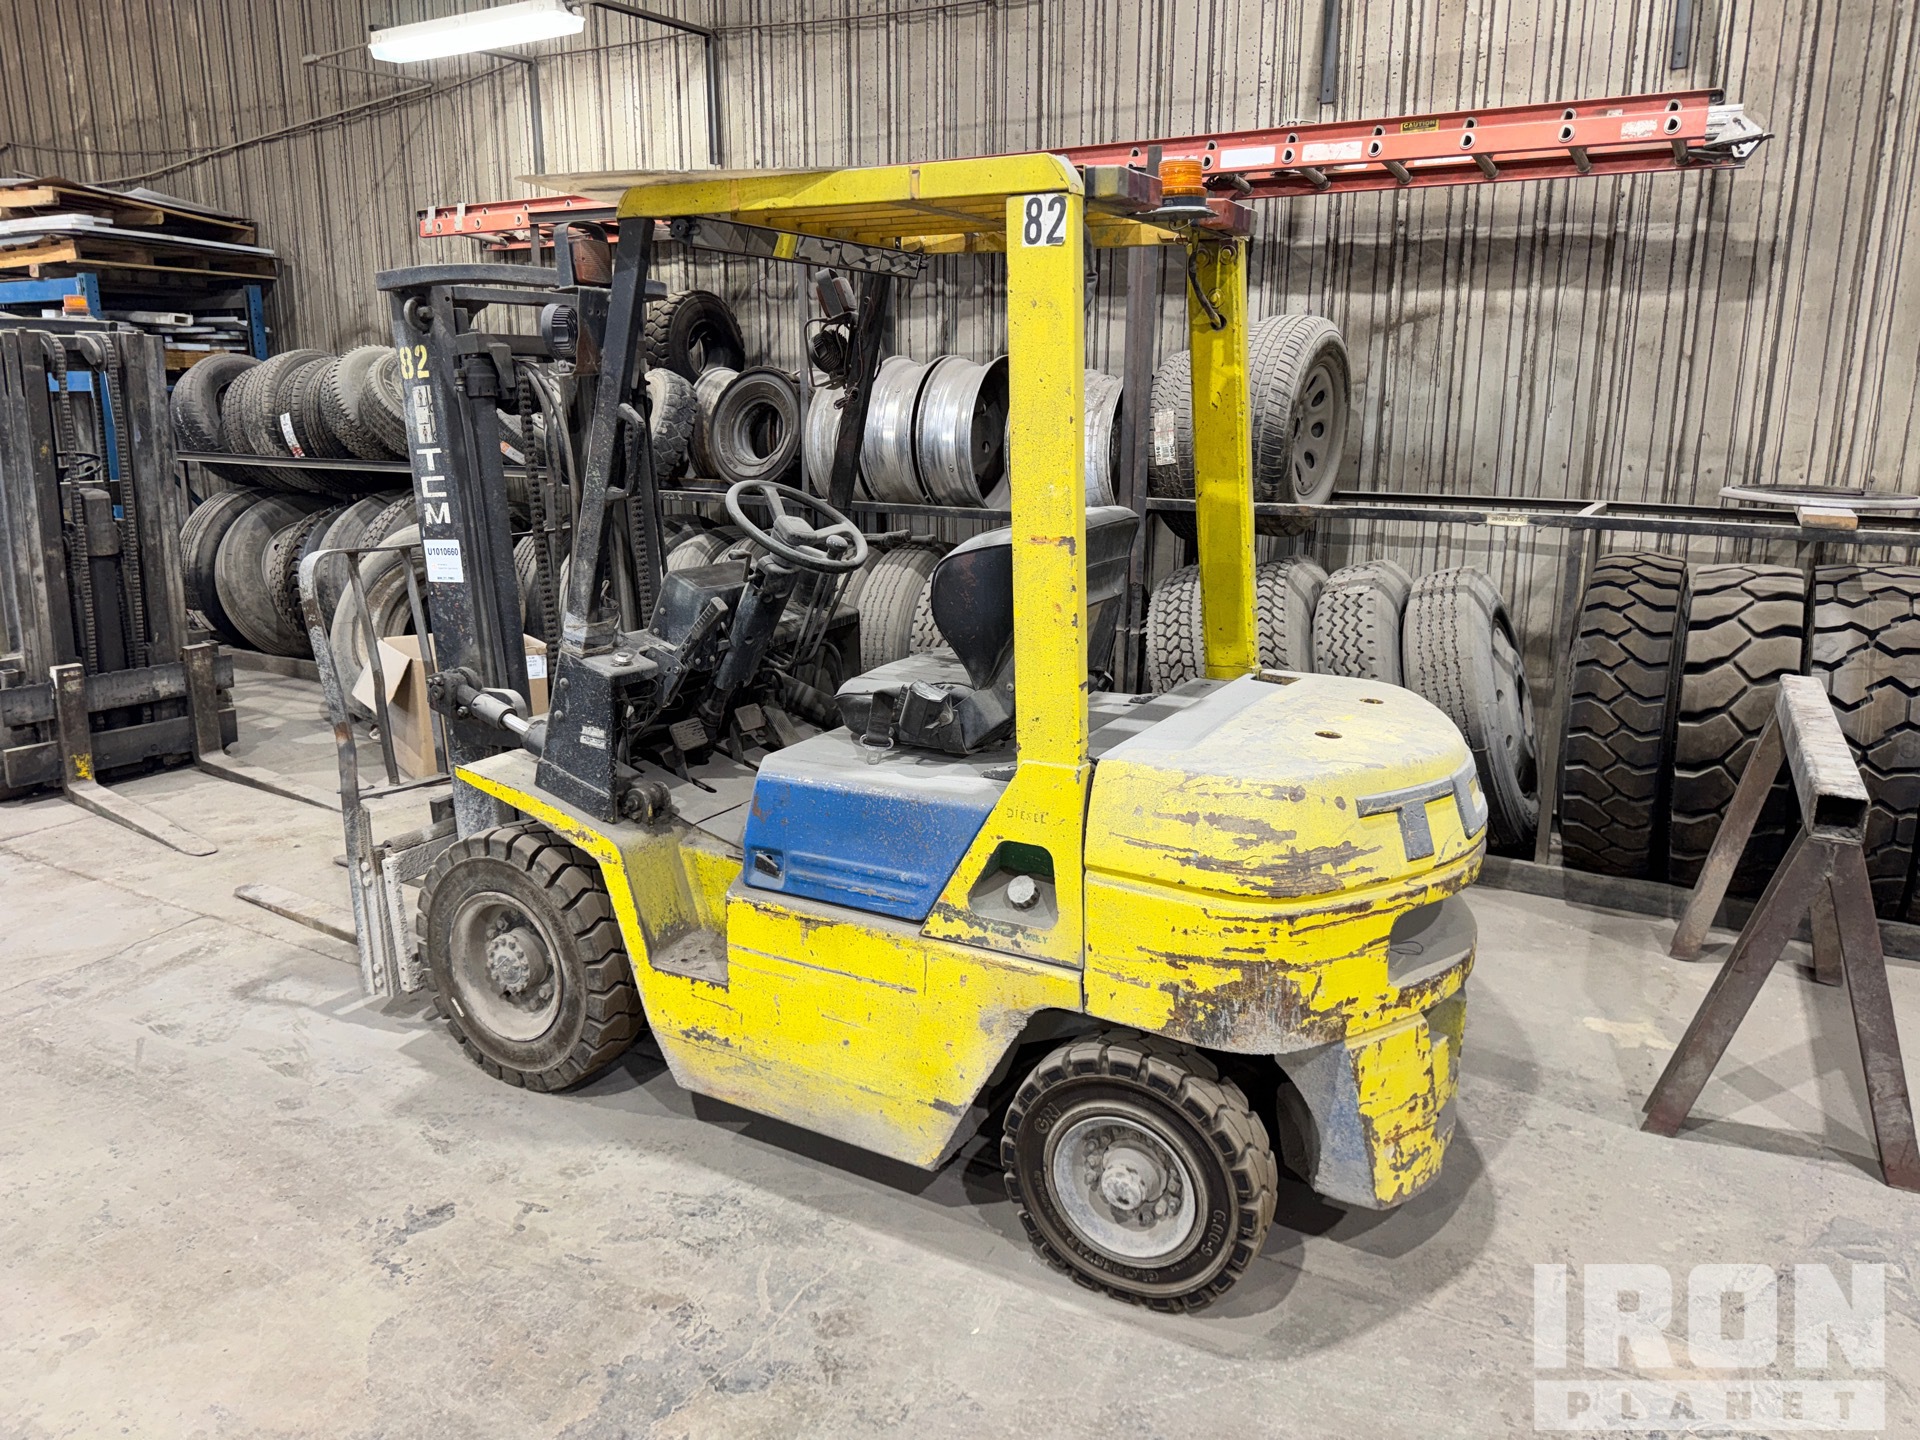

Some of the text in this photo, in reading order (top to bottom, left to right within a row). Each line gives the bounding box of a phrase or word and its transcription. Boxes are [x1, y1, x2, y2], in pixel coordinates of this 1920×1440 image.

[1403, 120, 1436, 129] CAUTION
[1024, 195, 1067, 245] 82
[399, 344, 430, 380] 82
[416, 447, 452, 525] TCM
[427, 547, 459, 556] U1010660
[1006, 807, 1047, 825] DIESEL
[1034, 1102, 1062, 1134] GRI
